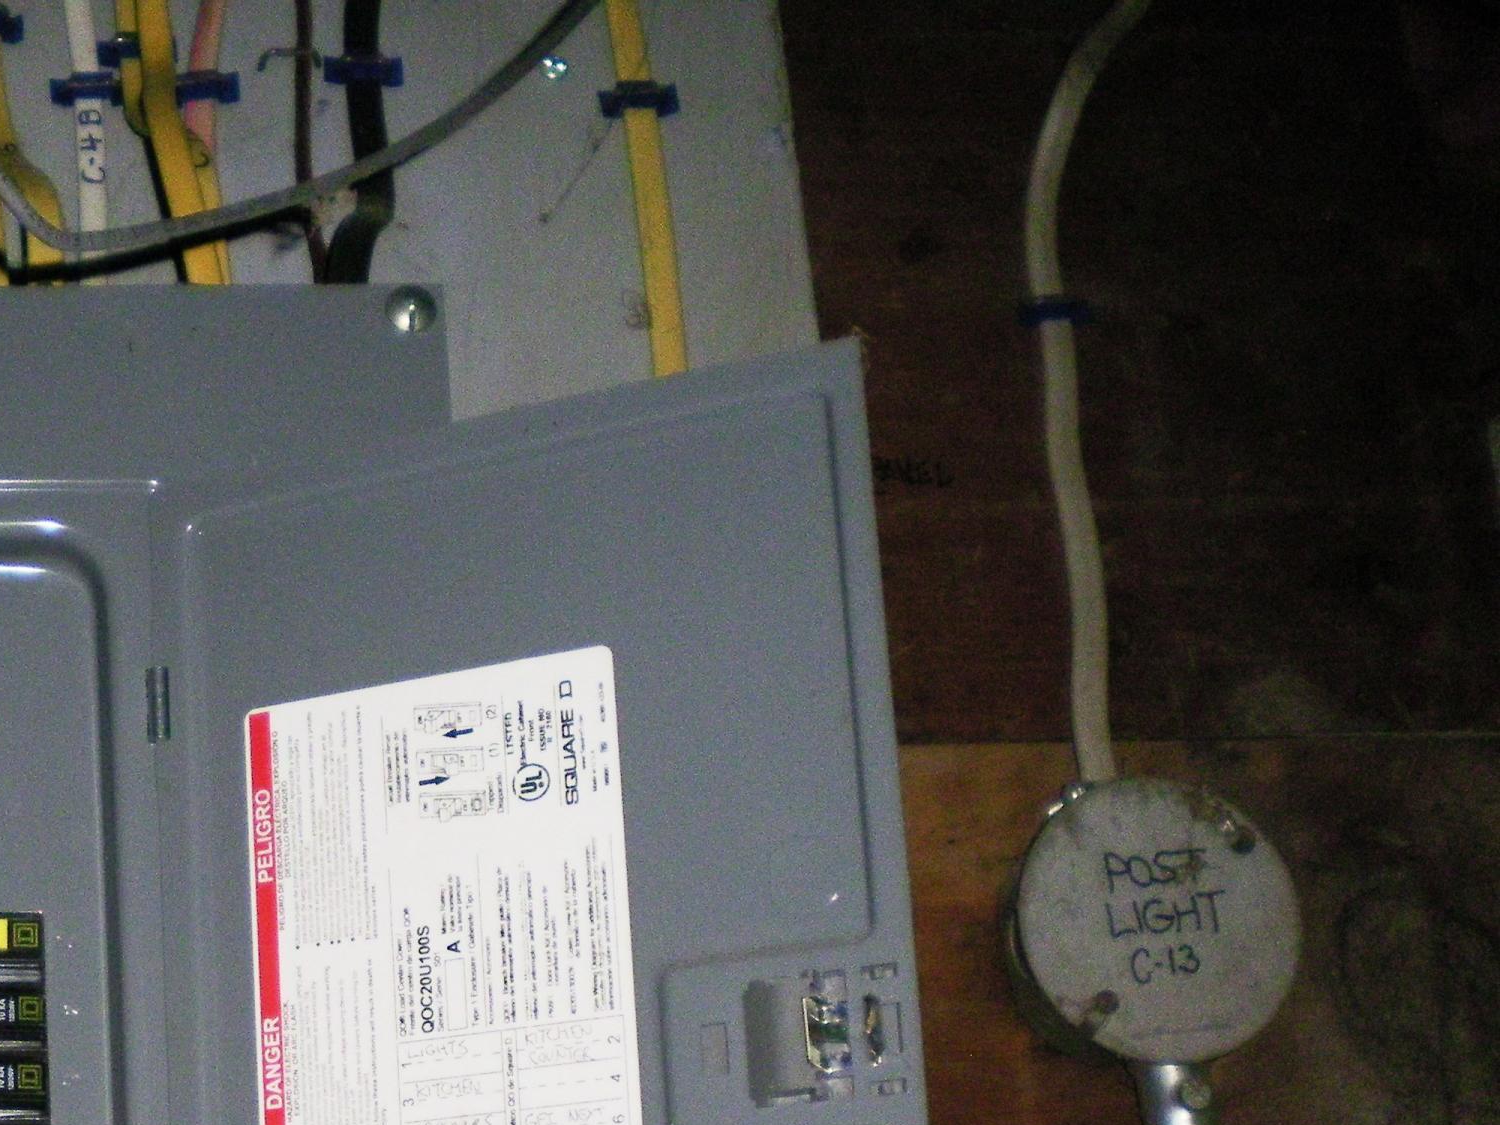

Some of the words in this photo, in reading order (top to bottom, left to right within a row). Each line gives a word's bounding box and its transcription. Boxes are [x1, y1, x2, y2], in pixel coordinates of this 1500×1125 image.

[558, 680, 573, 699] D
[486, 704, 499, 720] (2)
[487, 743, 500, 757] (1)
[560, 708, 580, 806] SQUARE
[254, 788, 275, 883] PELIGRO
[1104, 889, 1227, 938] LIGHT
[446, 940, 461, 953] A
[1130, 944, 1201, 985] C-13
[416, 926, 435, 1033] QOC20U100S
[607, 1035, 622, 1046] 2
[262, 1016, 284, 1110] DANGER
[609, 1073, 621, 1082] 4
[402, 1097, 414, 1107] 3
[611, 1114, 625, 1124] 6
